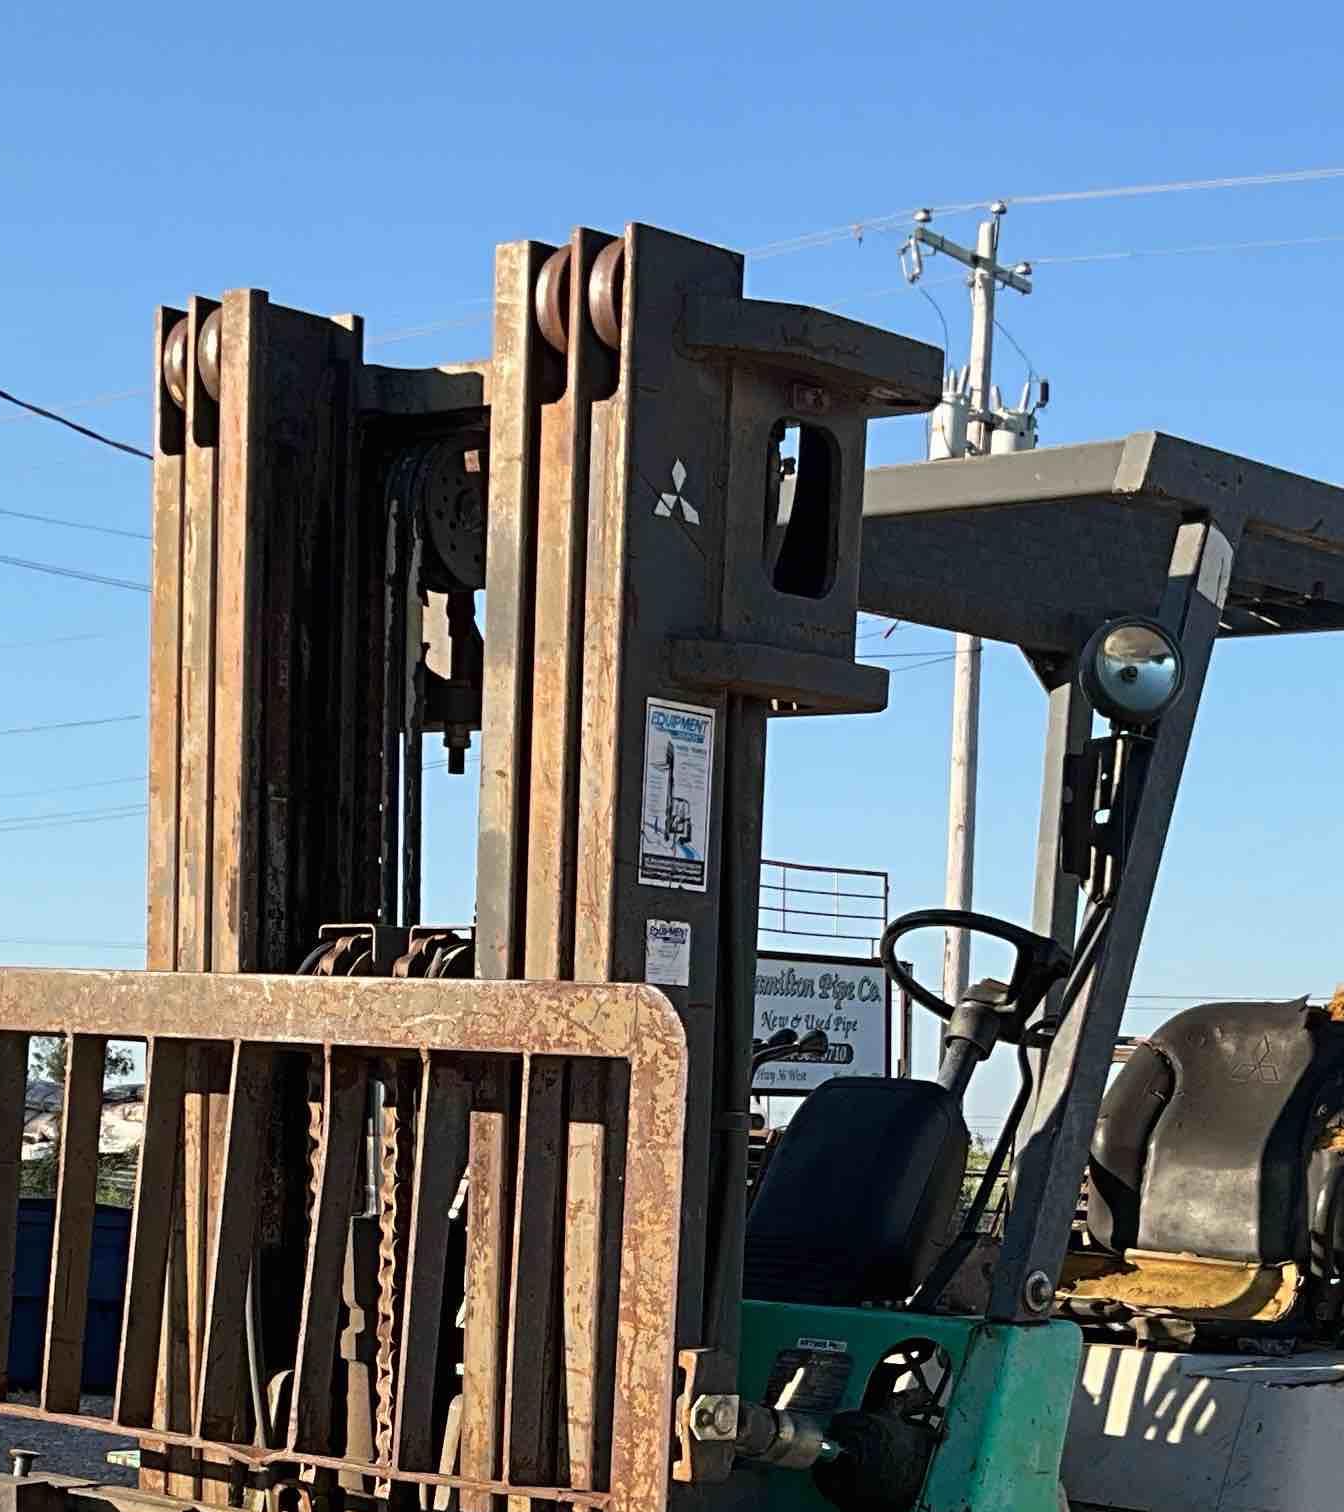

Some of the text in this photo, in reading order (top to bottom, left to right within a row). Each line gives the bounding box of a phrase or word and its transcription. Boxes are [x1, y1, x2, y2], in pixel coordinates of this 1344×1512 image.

[651, 711, 709, 734] EQUIPMENT
[818, 973, 855, 1010] Pipe
[761, 1010, 858, 1039] New & Used Pipe
